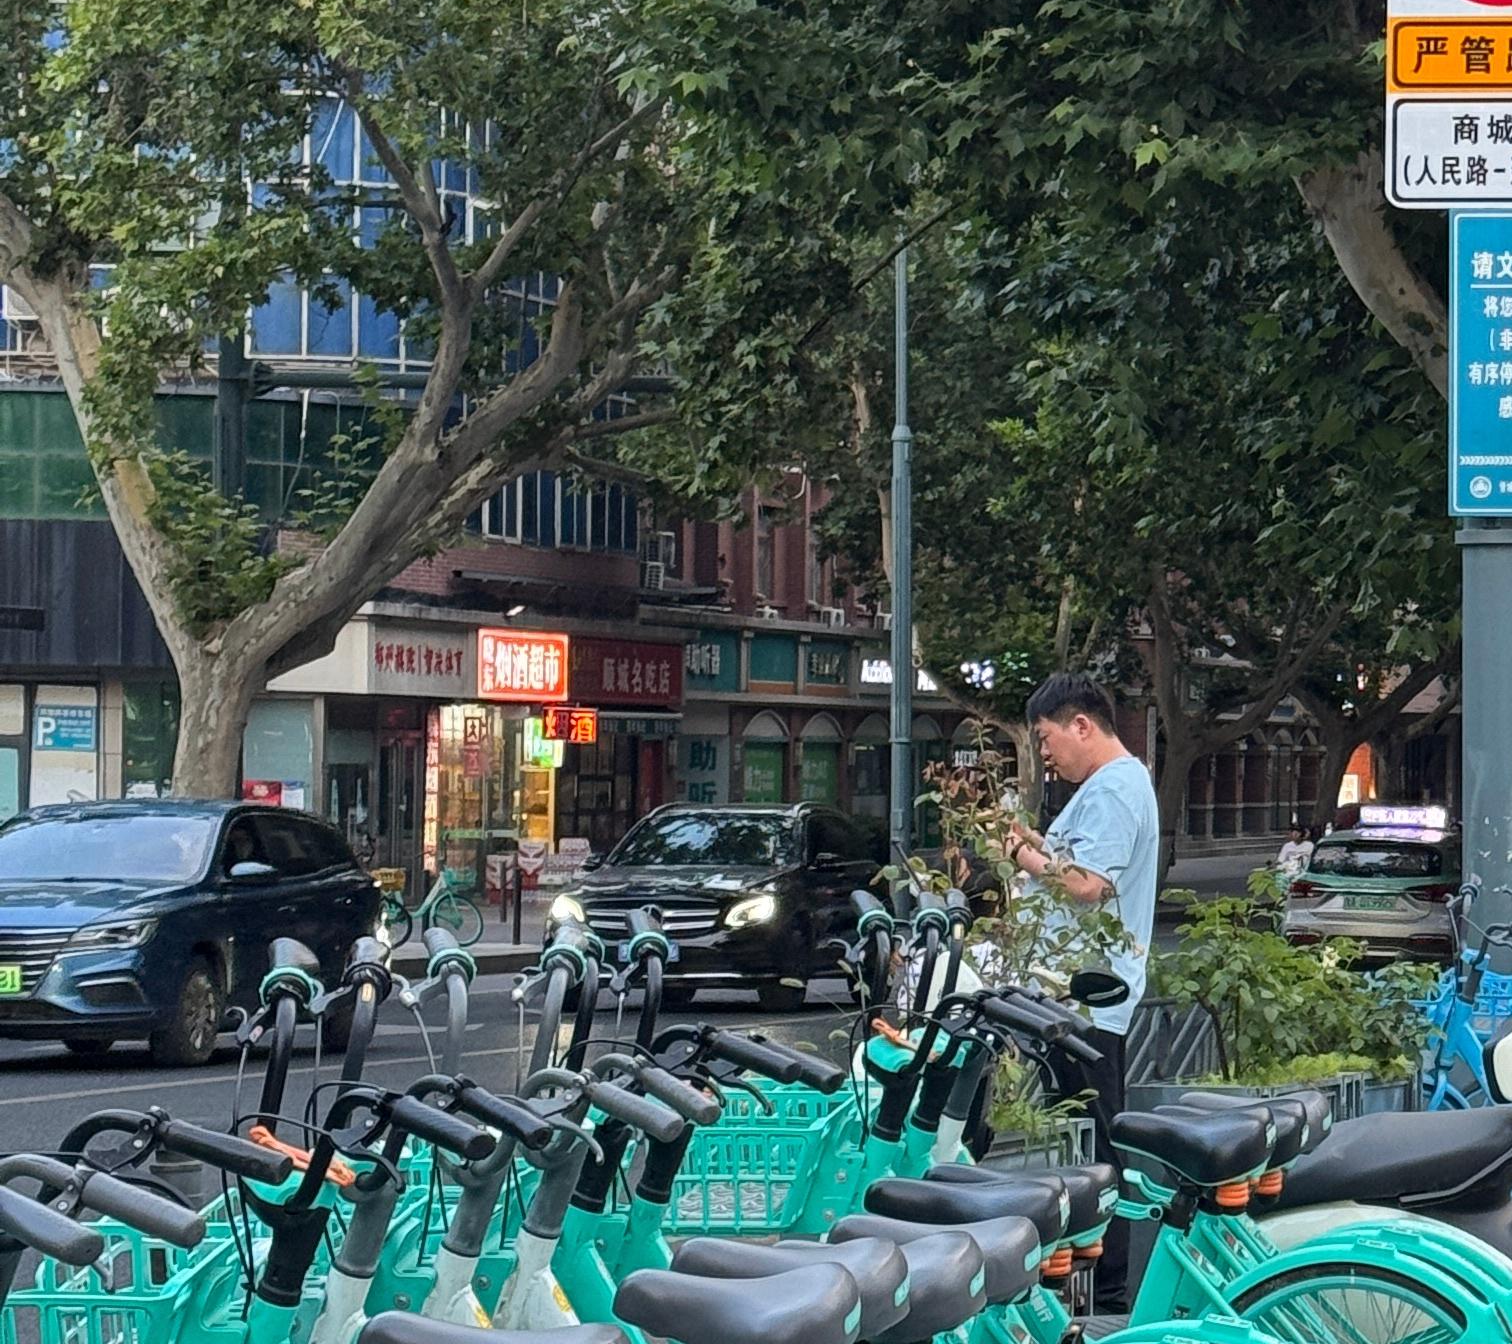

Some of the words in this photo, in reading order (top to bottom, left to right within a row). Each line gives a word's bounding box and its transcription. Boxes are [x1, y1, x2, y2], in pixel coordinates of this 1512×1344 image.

[495, 640, 561, 692] 烟酒超市
[545, 709, 597, 742] 烟酒
